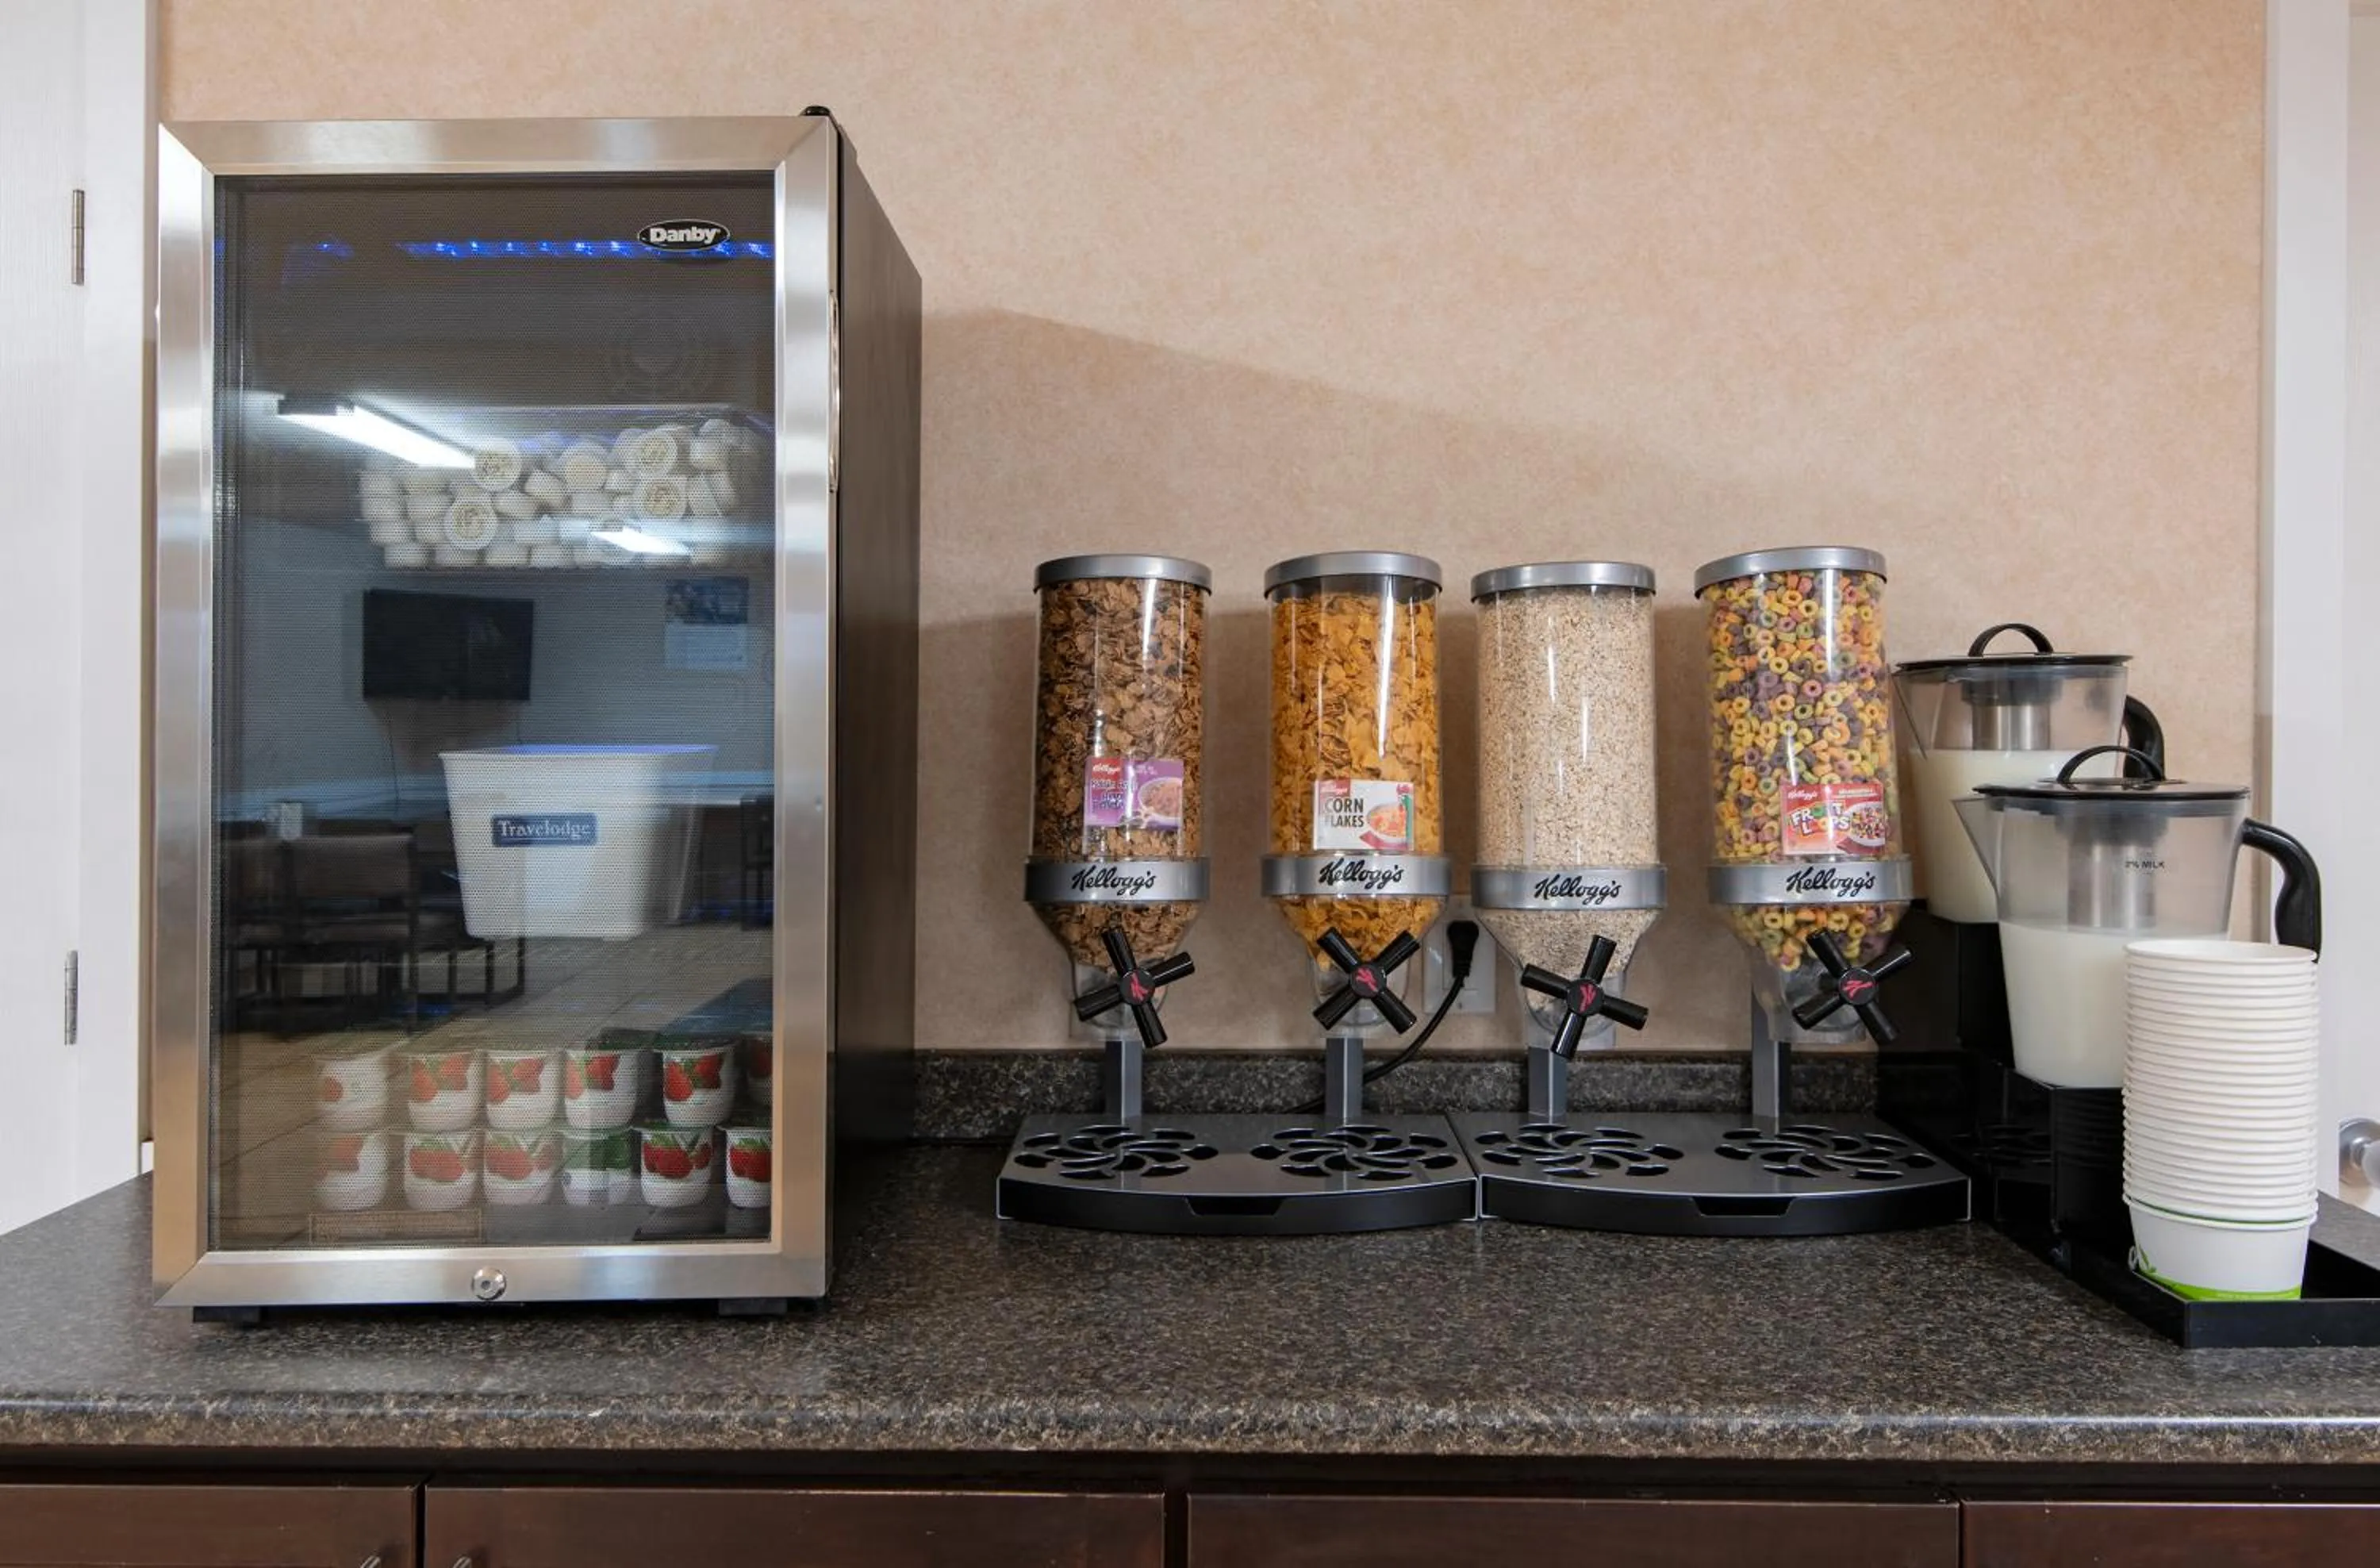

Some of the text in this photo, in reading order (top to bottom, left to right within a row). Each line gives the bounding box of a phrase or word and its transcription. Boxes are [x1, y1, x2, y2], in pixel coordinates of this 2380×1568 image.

[650, 227, 719, 244] Danby
[1325, 798, 1364, 813] CORN
[498, 820, 592, 840] Travelodge
[1318, 857, 1404, 890] Kellogg's
[2142, 860, 2165, 869] MILK
[1071, 865, 1157, 896] Kellogg's
[1534, 873, 1622, 905] Kellogg's
[1787, 867, 1876, 897] Kellogg's
